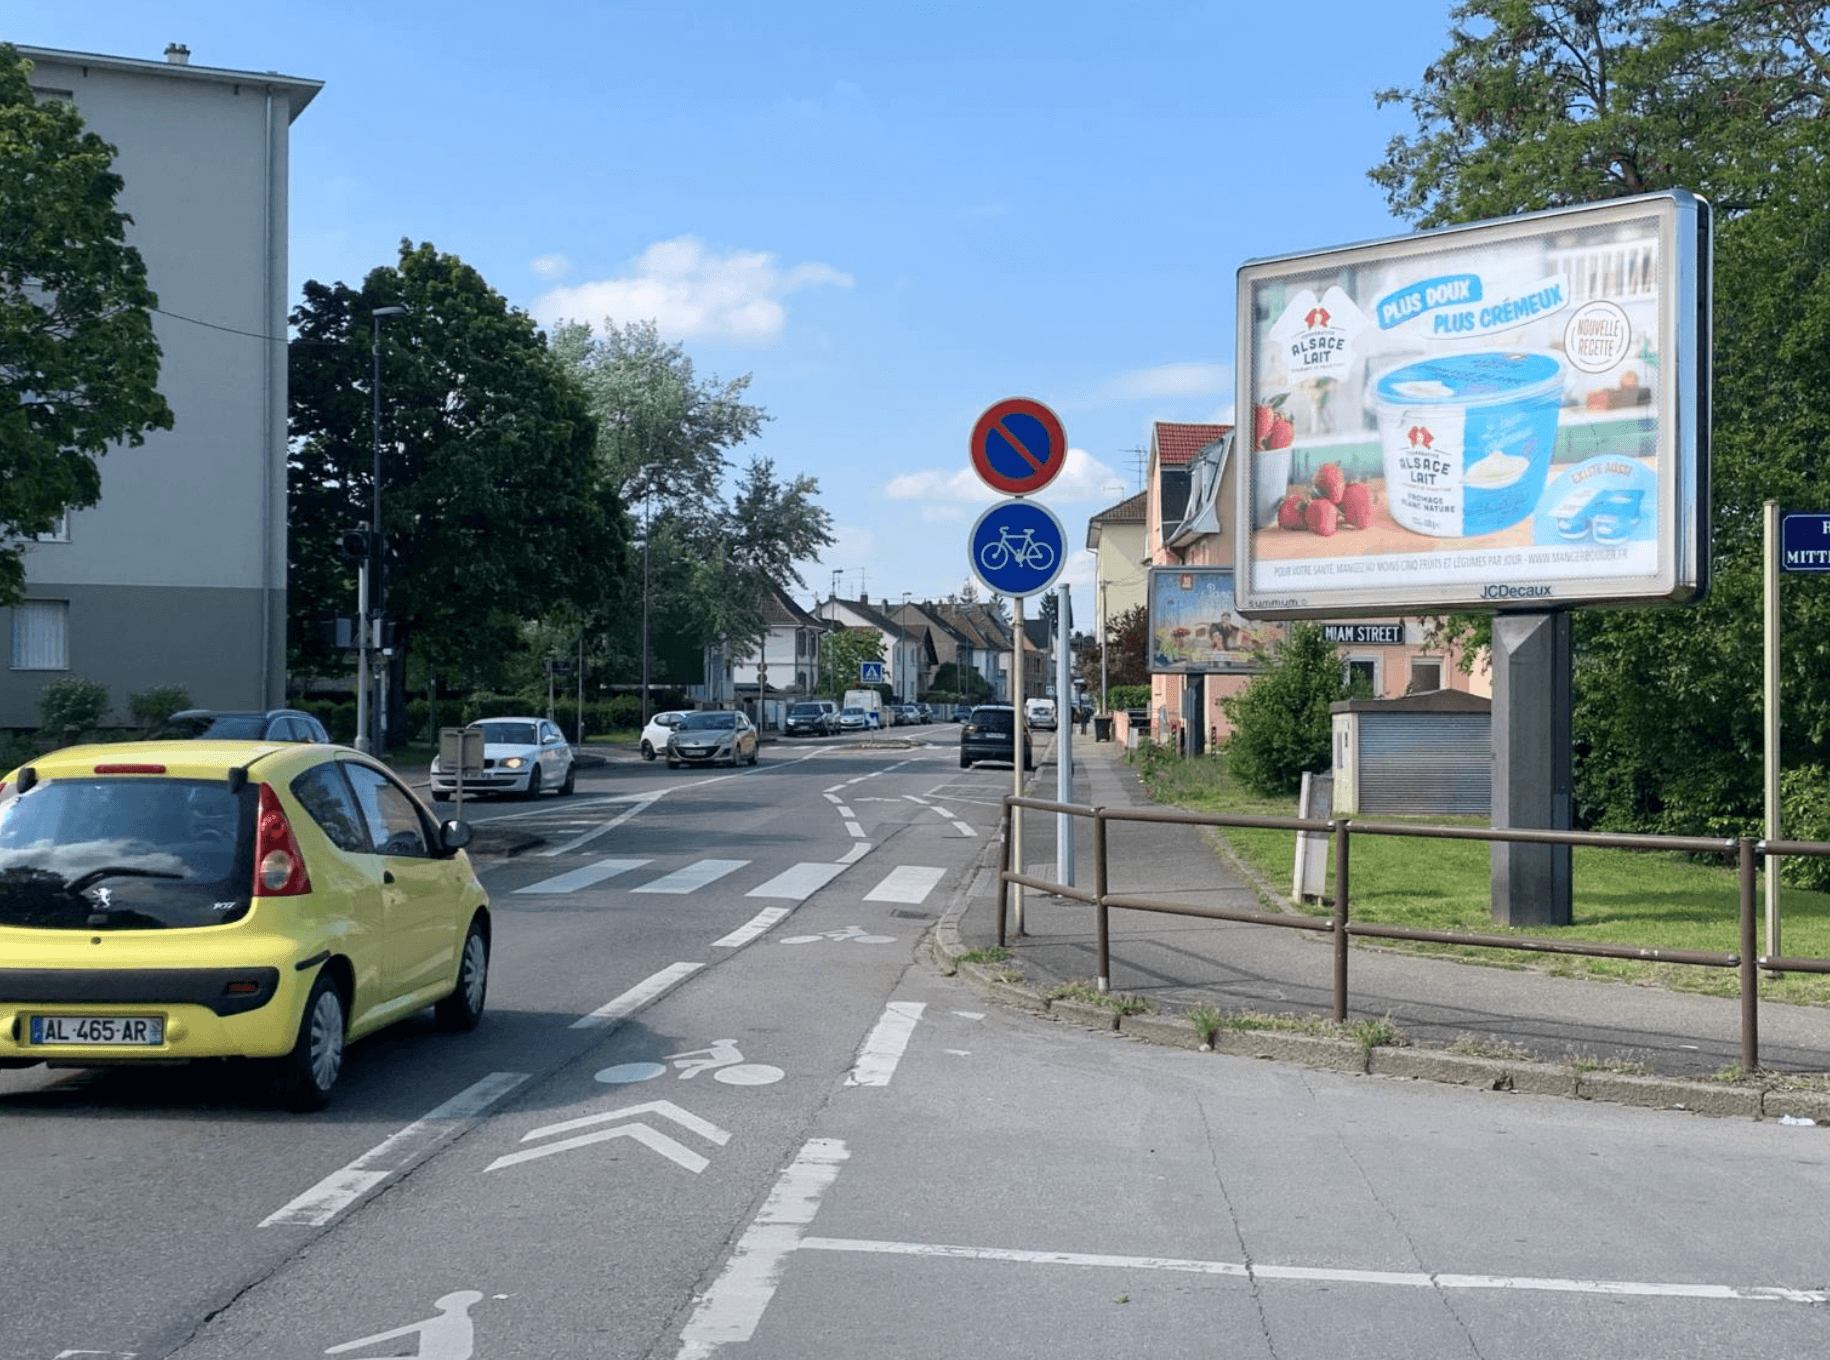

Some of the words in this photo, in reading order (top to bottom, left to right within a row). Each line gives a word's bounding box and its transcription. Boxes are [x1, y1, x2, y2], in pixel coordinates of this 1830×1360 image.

[1382, 292, 1421, 324] PLUS
[1425, 280, 1471, 306] DOUX
[1434, 311, 1475, 334] PLUS
[1480, 284, 1564, 328] CRÉMEUX
[1577, 318, 1619, 337] NOUVELLE
[1291, 336, 1345, 357] ALSACE
[1578, 338, 1615, 357] RECETTE
[1303, 350, 1331, 365] LAIT
[1399, 457, 1451, 477] ALSACE
[1410, 471, 1437, 485] LAIT
[1480, 584, 1552, 599] JCDecaux
[1325, 626, 1353, 642] MIAM
[1357, 626, 1399, 642] STREET
[44, 1019, 147, 1042] AL-465-AR
